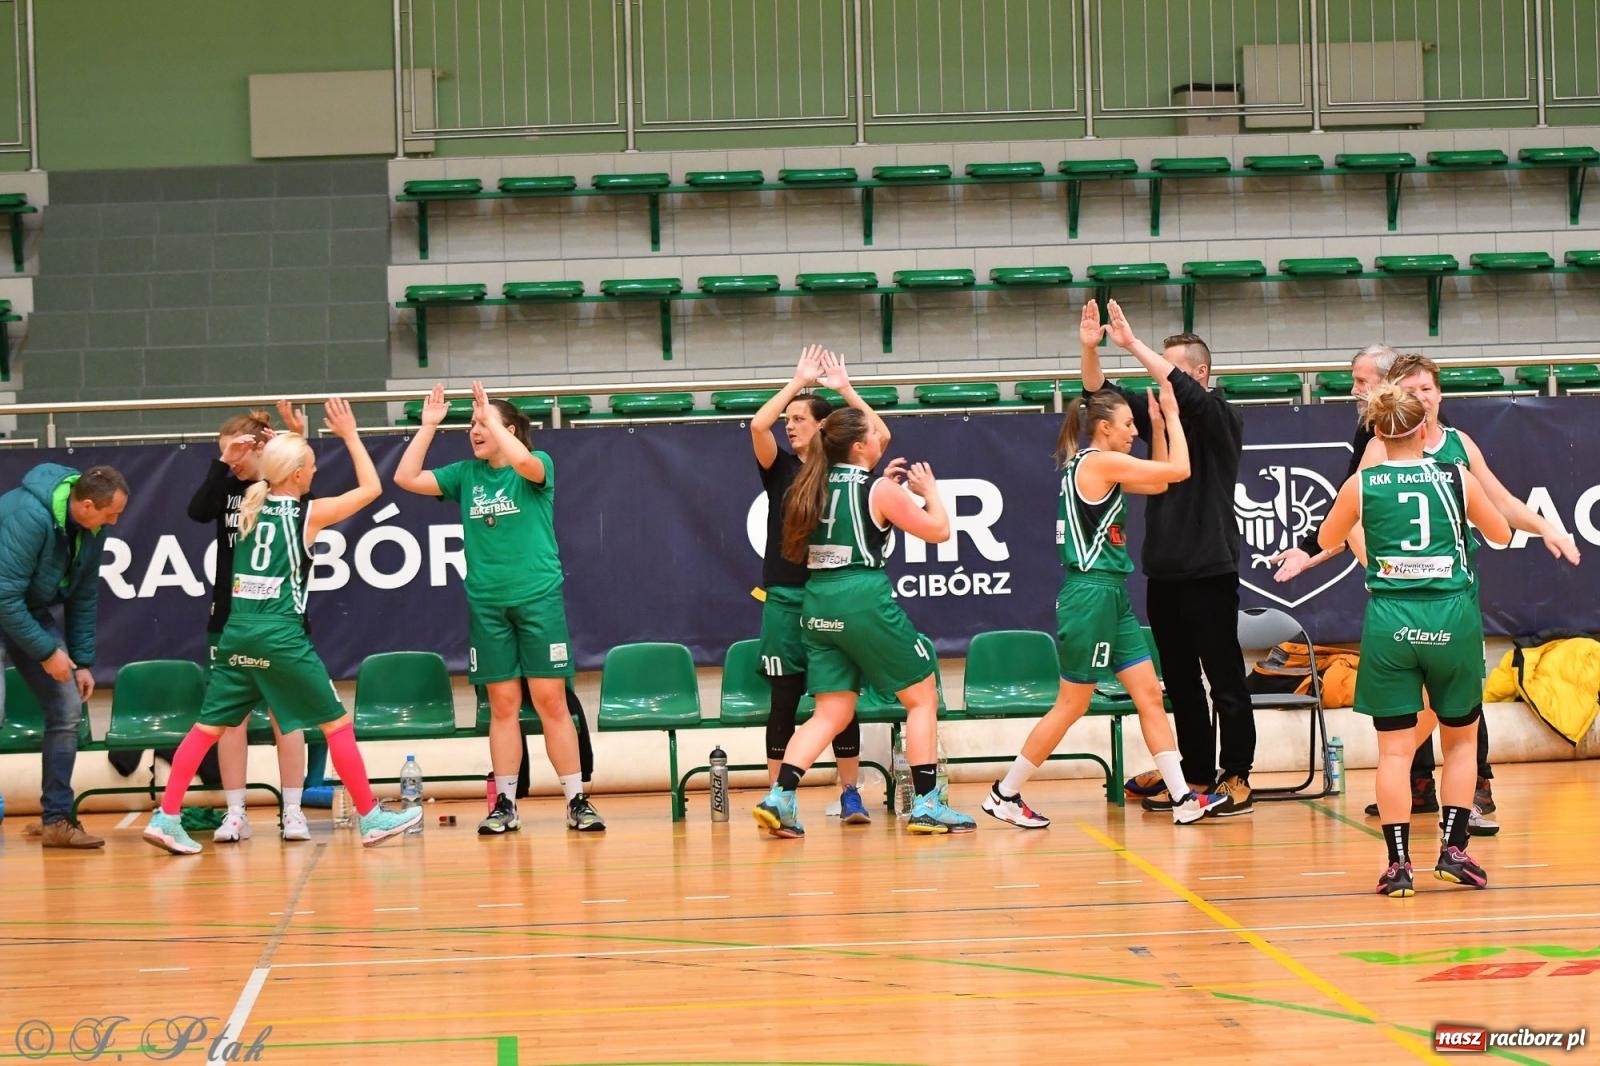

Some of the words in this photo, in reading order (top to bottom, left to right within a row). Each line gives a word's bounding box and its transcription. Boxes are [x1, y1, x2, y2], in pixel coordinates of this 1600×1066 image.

[1369, 473, 1391, 486] RKK
[1397, 491, 1431, 551] 3
[250, 521, 276, 571] 8
[814, 618, 845, 630] Clavis
[1407, 628, 1452, 642] Clavis
[237, 655, 271, 668] Clavis
[469, 647, 478, 672] 9
[914, 638, 931, 662] 4
[1091, 641, 1111, 668] 13
